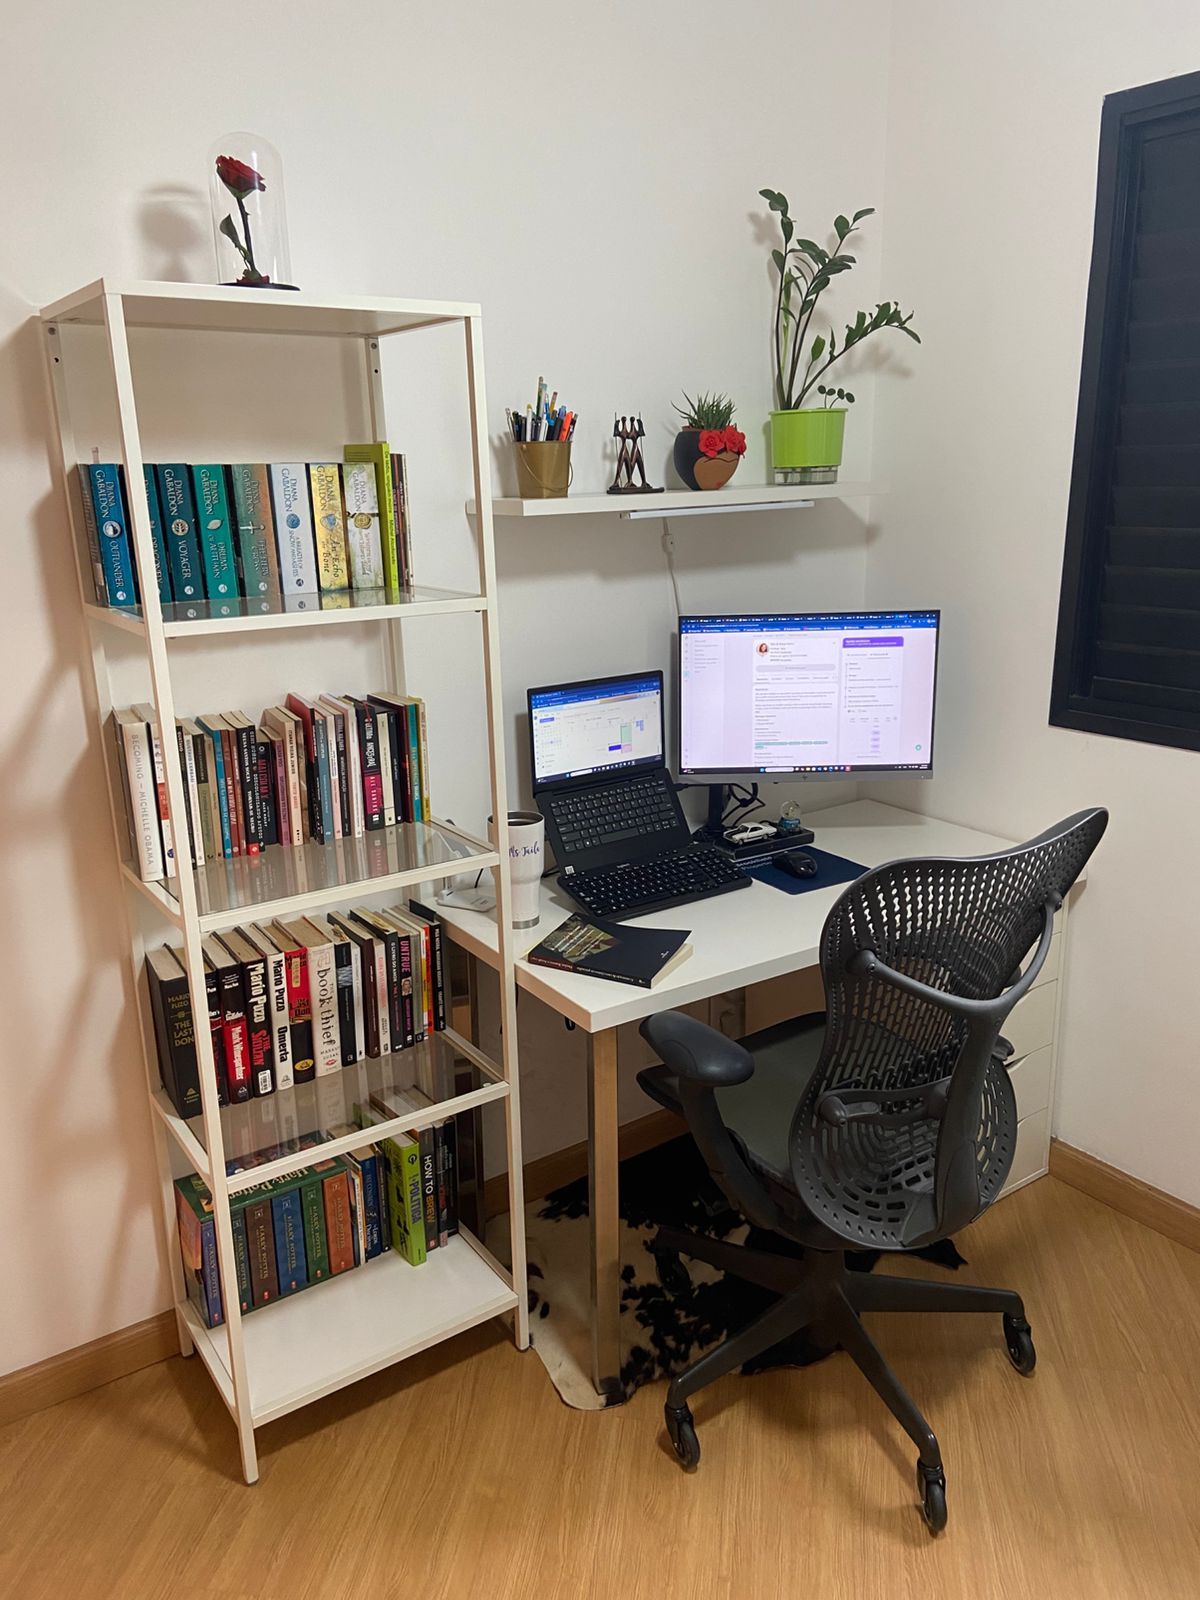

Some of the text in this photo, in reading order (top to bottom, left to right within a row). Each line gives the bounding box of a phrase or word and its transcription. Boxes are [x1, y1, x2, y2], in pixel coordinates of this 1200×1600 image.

[95, 469, 110, 518] GABALDON
[106, 481, 115, 507] DIANA
[164, 469, 178, 516] GABALDON
[174, 480, 183, 505] DIANA
[201, 469, 214, 515] GABALDON
[209, 480, 219, 505] DIANA
[243, 469, 255, 515] GABALDON
[251, 480, 260, 504] DIANA
[281, 468, 293, 512] GABALDON
[290, 478, 298, 502] DIANA
[316, 465, 328, 511] GABALDON
[325, 475, 333, 503] DIANA
[353, 472, 361, 512] GABALDON
[109, 540, 124, 588] OUTLANDER
[179, 540, 191, 580] VOYAGER
[209, 542, 220, 578] AUTUMN
[217, 542, 228, 571] DRUMS
[322, 552, 330, 573] Bone
[332, 554, 343, 578] Echo
[131, 735, 154, 864] BECOMING MICHELLE OBAMA
[400, 941, 410, 973] UNTRUE
[168, 993, 190, 1002] MARIO
[247, 962, 267, 1023] Mario Puzo
[273, 960, 286, 1013] Mario Puzo
[171, 1000, 188, 1009] PUZO
[317, 968, 336, 1046] book thief
[173, 1027, 193, 1039] LAST
[175, 1020, 191, 1030] THE
[232, 1026, 242, 1042] Mark
[175, 1036, 194, 1047] DON
[263, 1033, 271, 1051] THE
[277, 1026, 288, 1063] Omerta
[423, 1155, 436, 1222] HOW TO BREW
